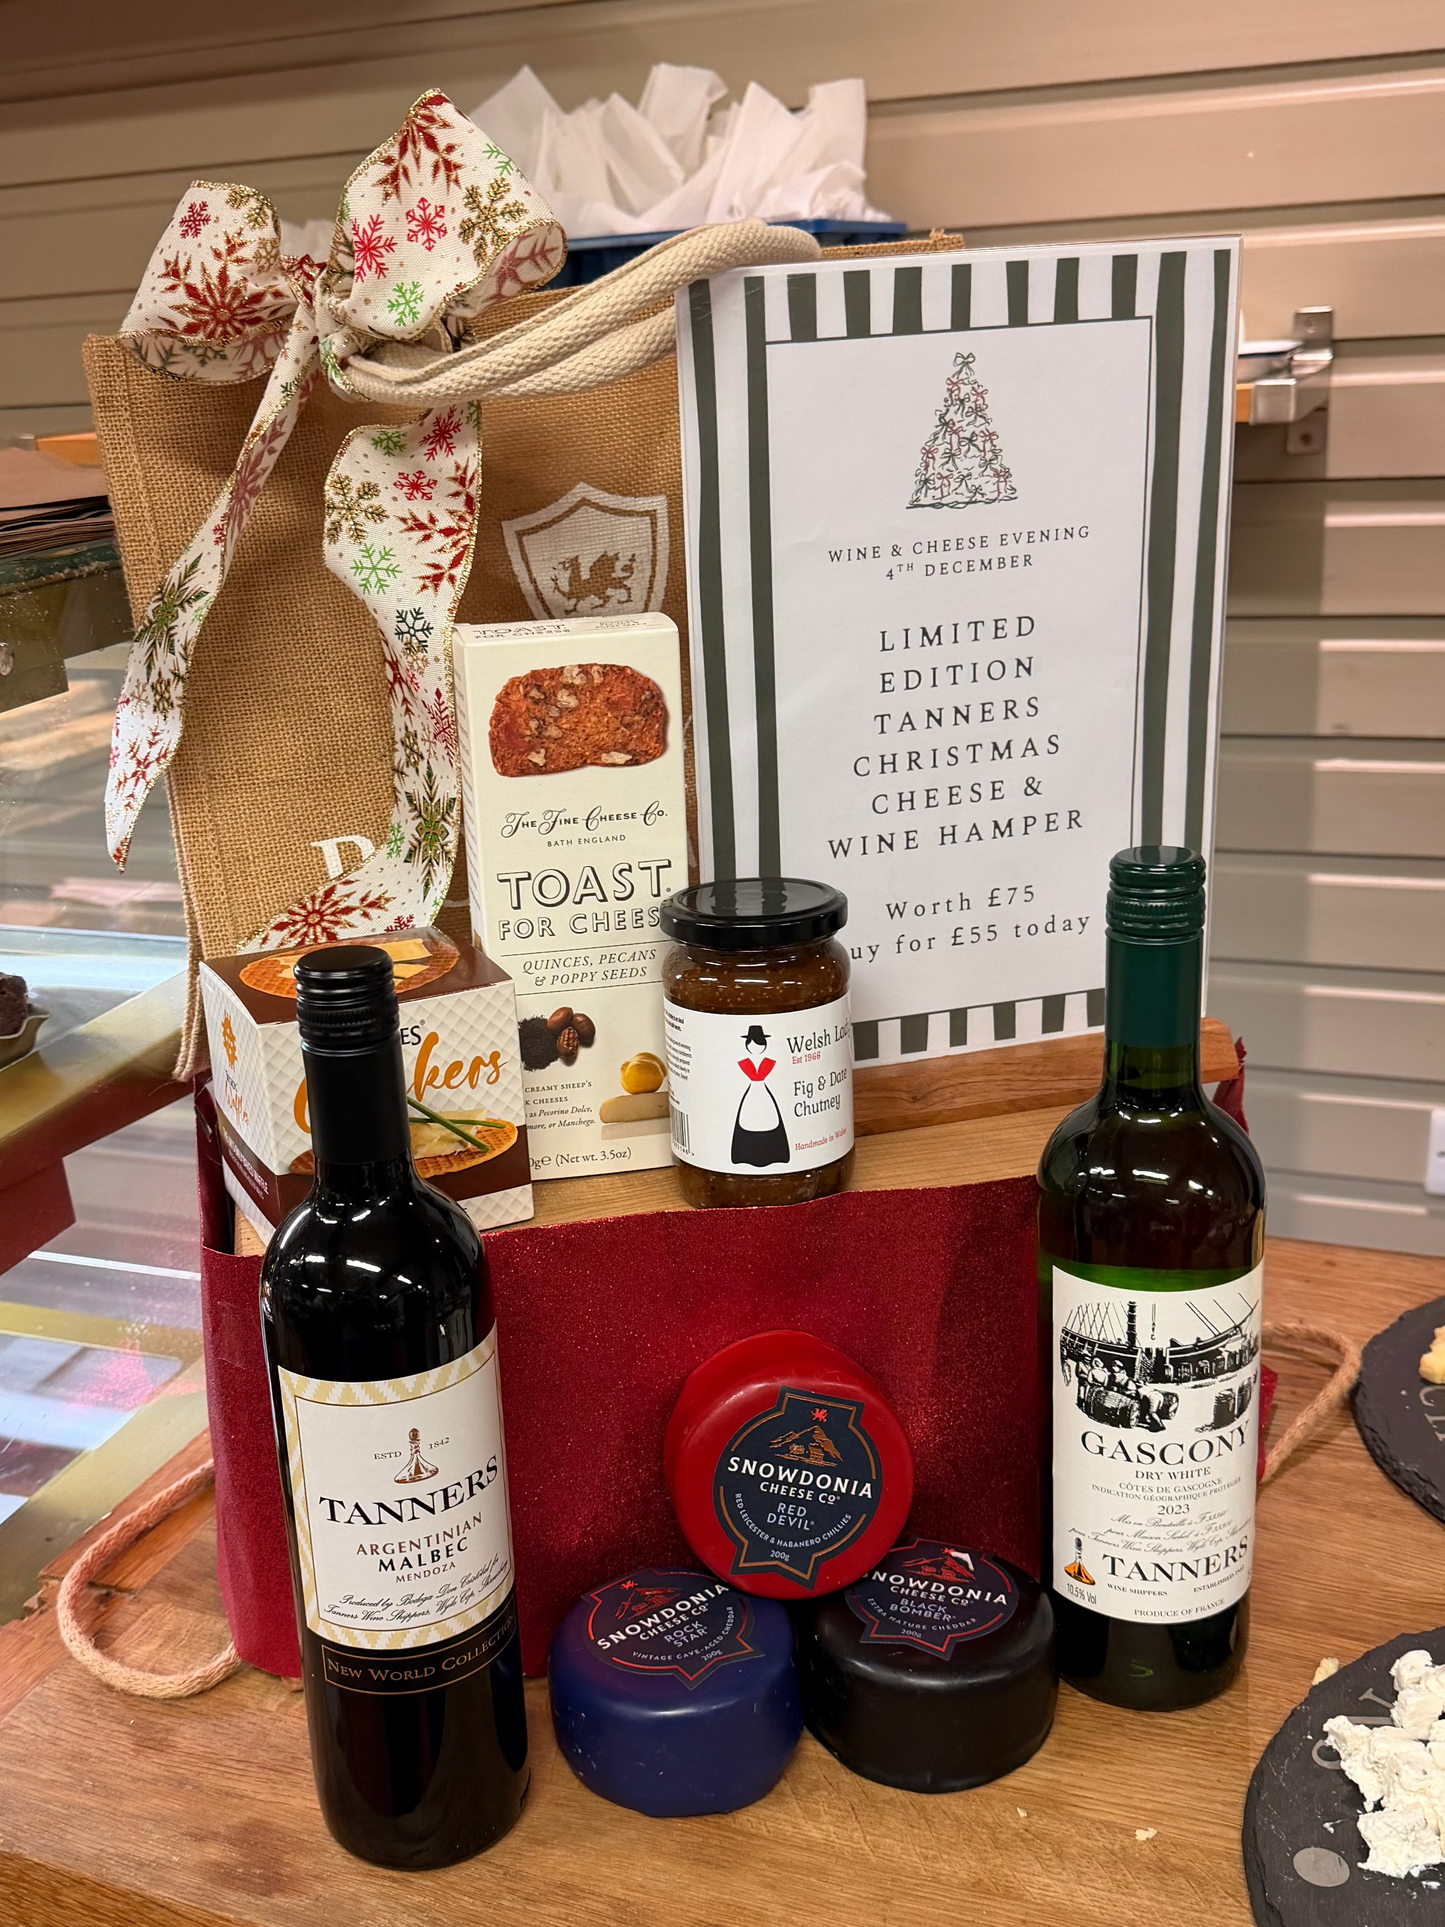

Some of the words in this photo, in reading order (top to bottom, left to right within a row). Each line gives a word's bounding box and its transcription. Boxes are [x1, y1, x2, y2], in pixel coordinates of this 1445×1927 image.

[828, 545, 882, 563] WINE
[890, 544, 903, 557] &
[912, 535, 989, 555] CHEESE
[999, 525, 1091, 547] EVENING
[886, 562, 915, 581] 4TH
[924, 554, 1034, 577] DECEMBER
[879, 615, 1036, 652] LIMITED
[879, 656, 1034, 694] EDITION
[873, 696, 1039, 735] TANNERS
[853, 734, 1061, 777] CHRISTMAS
[871, 780, 1006, 815] CHEESE
[1023, 776, 1043, 797] &
[547, 839, 573, 848] BATH
[577, 834, 626, 845] ENGLAND
[827, 830, 920, 859] WINE
[938, 809, 1084, 846] HAMPER
[885, 892, 972, 920] Worth
[988, 885, 1036, 908] £75
[498, 916, 556, 941] FOR
[569, 906, 660, 935] CHEES
[850, 943, 881, 963] uy
[895, 934, 937, 954] for
[950, 924, 999, 946] £55
[1014, 914, 1091, 938] today
[522, 955, 594, 976] QUINCES,
[598, 949, 657, 966] PECANS
[534, 976, 546, 987] &
[550, 971, 598, 986] POPPY
[601, 966, 648, 981] SEEDS
[786, 1029, 831, 1054] Welsh
[792, 1055, 803, 1065] Est
[804, 1051, 821, 1063] 1966
[524, 1084, 559, 1093] CREAMY
[793, 1080, 814, 1099] Fig
[817, 1075, 827, 1091] &
[830, 1068, 848, 1087] Date
[532, 1096, 569, 1105] CHEESES
[538, 1108, 569, 1118] Pecorino
[570, 1104, 593, 1114] Dolce,
[794, 1093, 841, 1118] Chutney
[548, 1121, 557, 1129] or
[557, 1118, 596, 1128] Manchego.
[795, 1136, 828, 1151] Handmade
[829, 1133, 835, 1143] in
[555, 1153, 580, 1167] (Net
[582, 1154, 598, 1163] wt.
[600, 1146, 632, 1161] 3.5oz)
[373, 1450, 402, 1460] ESTD
[428, 1437, 450, 1450] 1842
[1081, 1419, 1250, 1466] GASCONY
[727, 1456, 873, 1499] SNOWDONIA
[1119, 1481, 1154, 1494] CÔTES
[1156, 1486, 1171, 1494] DE
[1173, 1476, 1223, 1493] GASCOGNE
[1135, 1470, 1164, 1481] DRY
[1168, 1466, 1211, 1480] WHITE
[319, 1454, 498, 1526] TANNERS
[759, 1481, 815, 1501] CHEESE
[1091, 1484, 1141, 1500] INDICATION
[735, 1493, 743, 1509] RED
[739, 1508, 770, 1542] LEICESTER
[769, 1537, 775, 1545] &
[776, 1536, 821, 1548] HABANERO
[822, 1513, 852, 1541] CHILLIES
[777, 1502, 807, 1517] RED
[1157, 1503, 1190, 1516] 2023
[356, 1511, 483, 1556] ARGENTINIAN
[378, 1537, 469, 1573] MALBEC
[770, 1549, 790, 1562] 200g
[1101, 1535, 1249, 1583] TANNERS
[395, 1562, 456, 1584] MENDOZA
[1107, 1582, 1127, 1592] WINE
[1129, 1588, 1168, 1597] SHIPPERS
[1193, 1572, 1235, 1593] ESTABLISHED
[862, 1570, 1008, 1606] NOWDONIA
[889, 1585, 946, 1603] CHEESE
[1066, 1582, 1086, 1601] 10.5%
[1086, 1590, 1098, 1605] Vol
[597, 1582, 730, 1651] SNOWDONIA
[867, 1597, 887, 1617] EXTRA
[888, 1615, 928, 1631] MATURE
[931, 1617, 977, 1631] CHEDDAR
[899, 1597, 948, 1614] BLACK
[1134, 1608, 1179, 1618] PRODUCE
[1180, 1606, 1193, 1616] OF
[1195, 1597, 1226, 1613] FRANCE
[632, 1650, 673, 1661] VINTAGE
[676, 1632, 724, 1660] CAVE-AGED
[721, 1606, 735, 1635] CHEDDAR
[639, 1614, 688, 1641] CHEESE
[664, 1620, 704, 1643] ROCK
